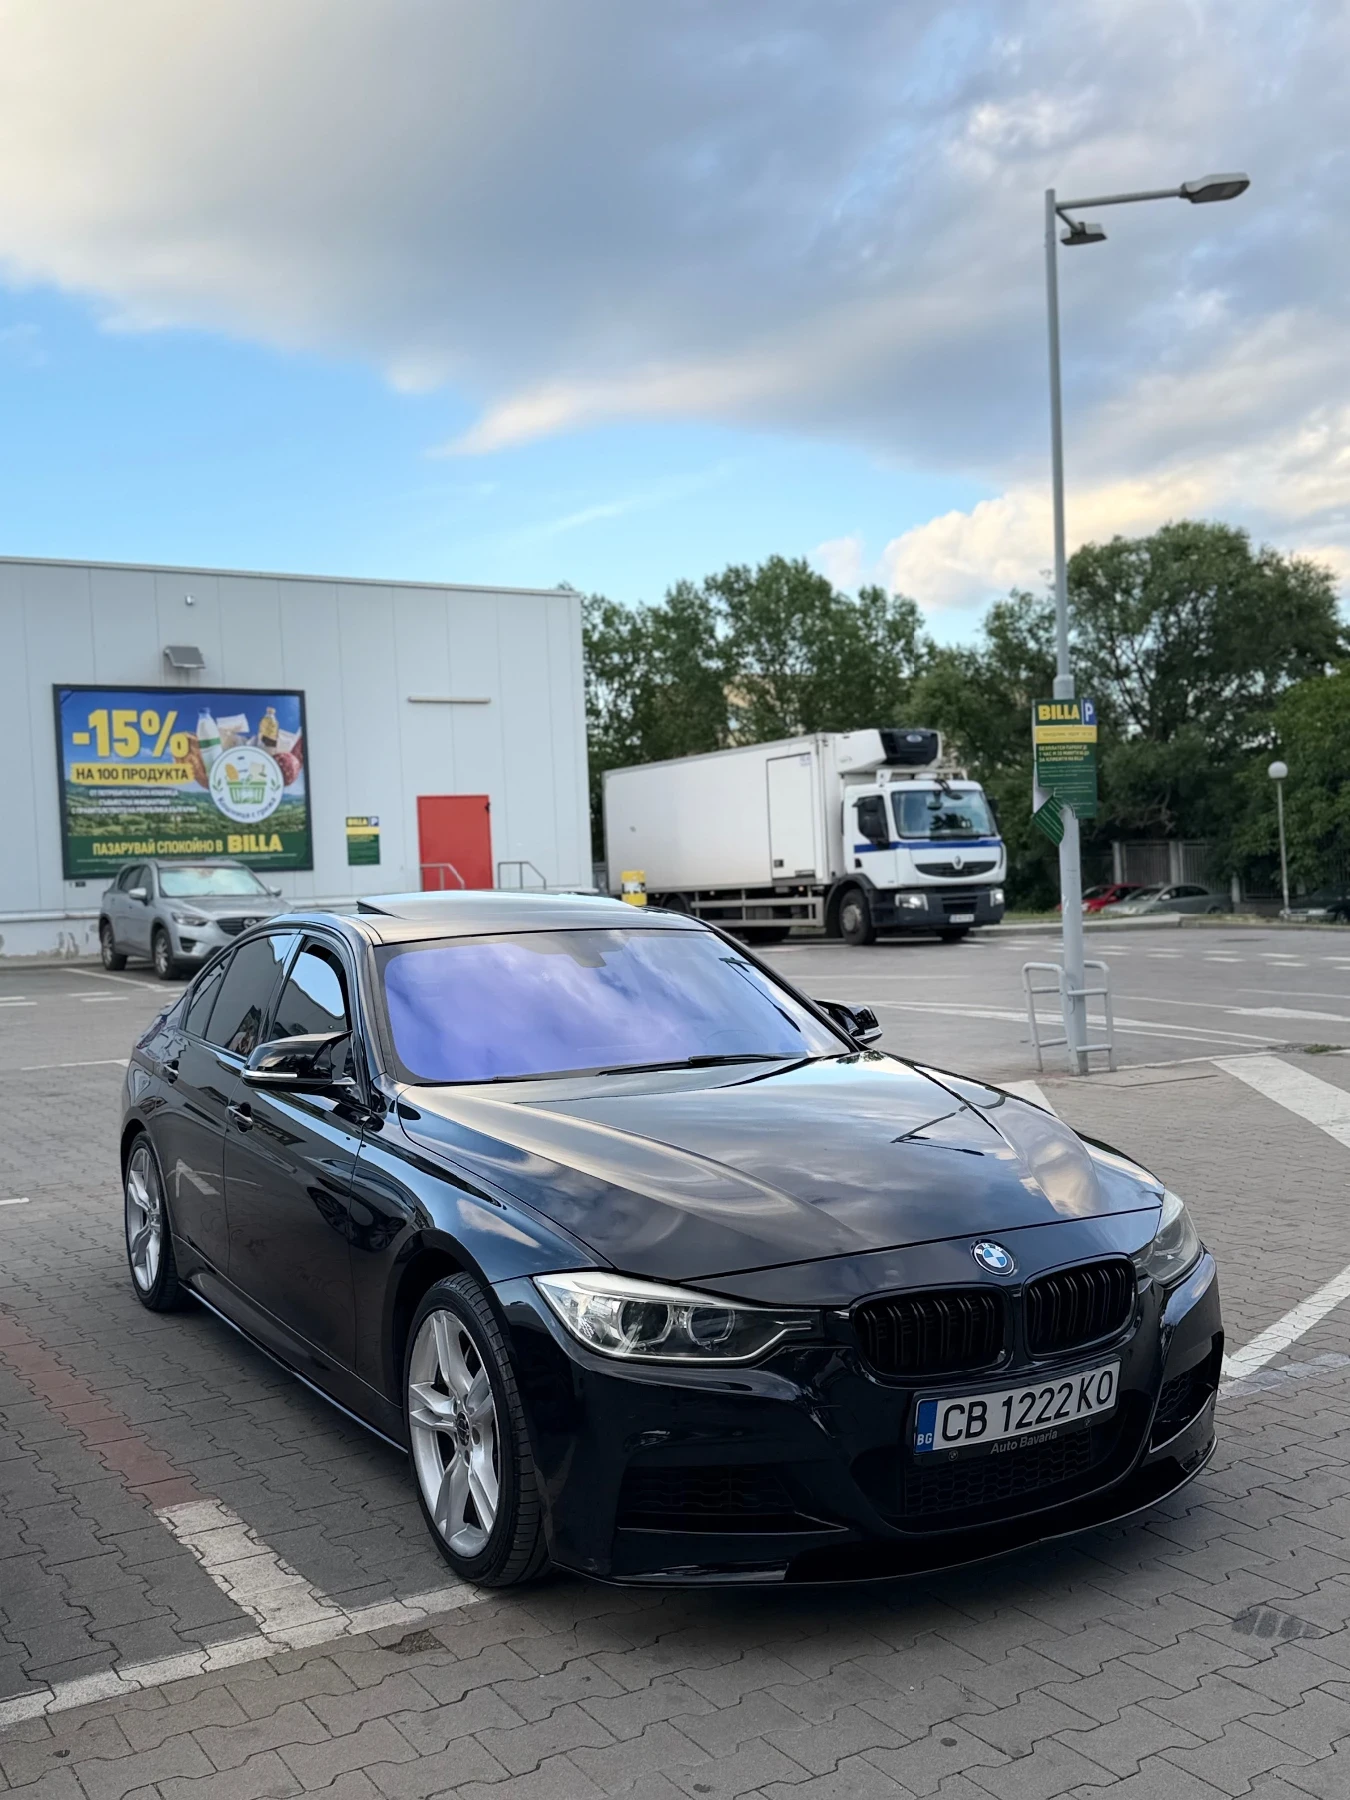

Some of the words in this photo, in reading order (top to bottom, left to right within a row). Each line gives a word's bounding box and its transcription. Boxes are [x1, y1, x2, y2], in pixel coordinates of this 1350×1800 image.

[1038, 704, 1080, 720] BILLA
[1085, 702, 1094, 722] P
[72, 709, 190, 758] -15%
[76, 768, 94, 779] НА
[98, 768, 118, 779] 100
[122, 768, 188, 782] ПРОДУКТА
[92, 838, 155, 855] ПАЗАРУВАЙ
[157, 836, 214, 854] СПОКОЙНО
[215, 839, 223, 852] В
[227, 834, 283, 853] BILLA
[941, 1400, 988, 1442] CB
[917, 1432, 934, 1446] BG
[990, 1439, 1018, 1455] Auto
[1019, 1429, 1058, 1447] Bavaria
